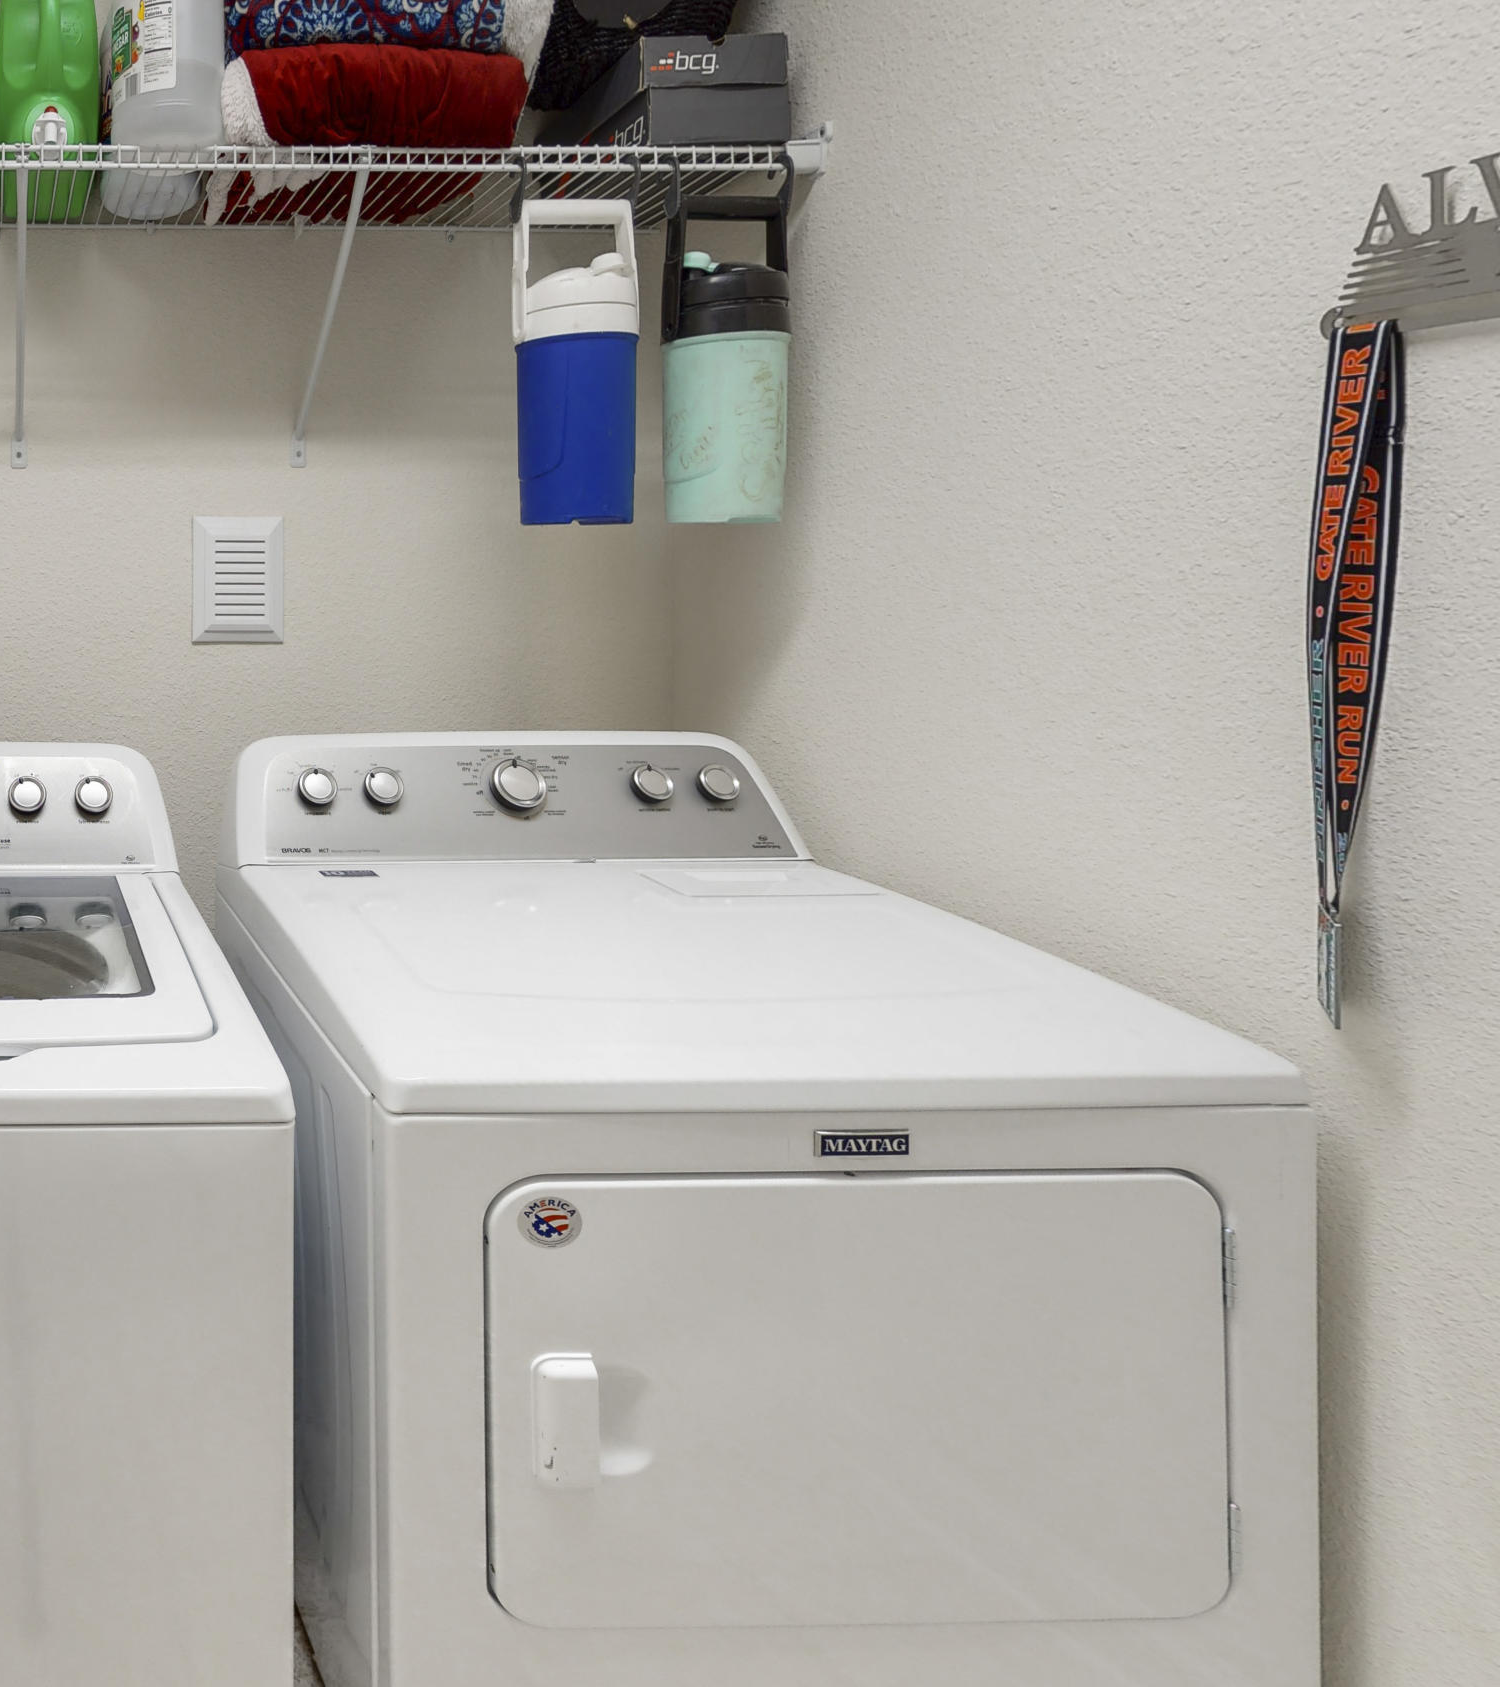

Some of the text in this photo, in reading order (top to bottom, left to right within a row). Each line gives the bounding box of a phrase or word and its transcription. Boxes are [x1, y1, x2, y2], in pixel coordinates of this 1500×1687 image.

[144, 9, 163, 18] Calories
[1327, 344, 1372, 477] RIVER
[1316, 484, 1346, 581] GATE
[1338, 573, 1375, 695] RIVER
[1336, 703, 1365, 785] RUN
[824, 1137, 908, 1153] MAYTAG
[523, 1199, 576, 1218] AMERICA
